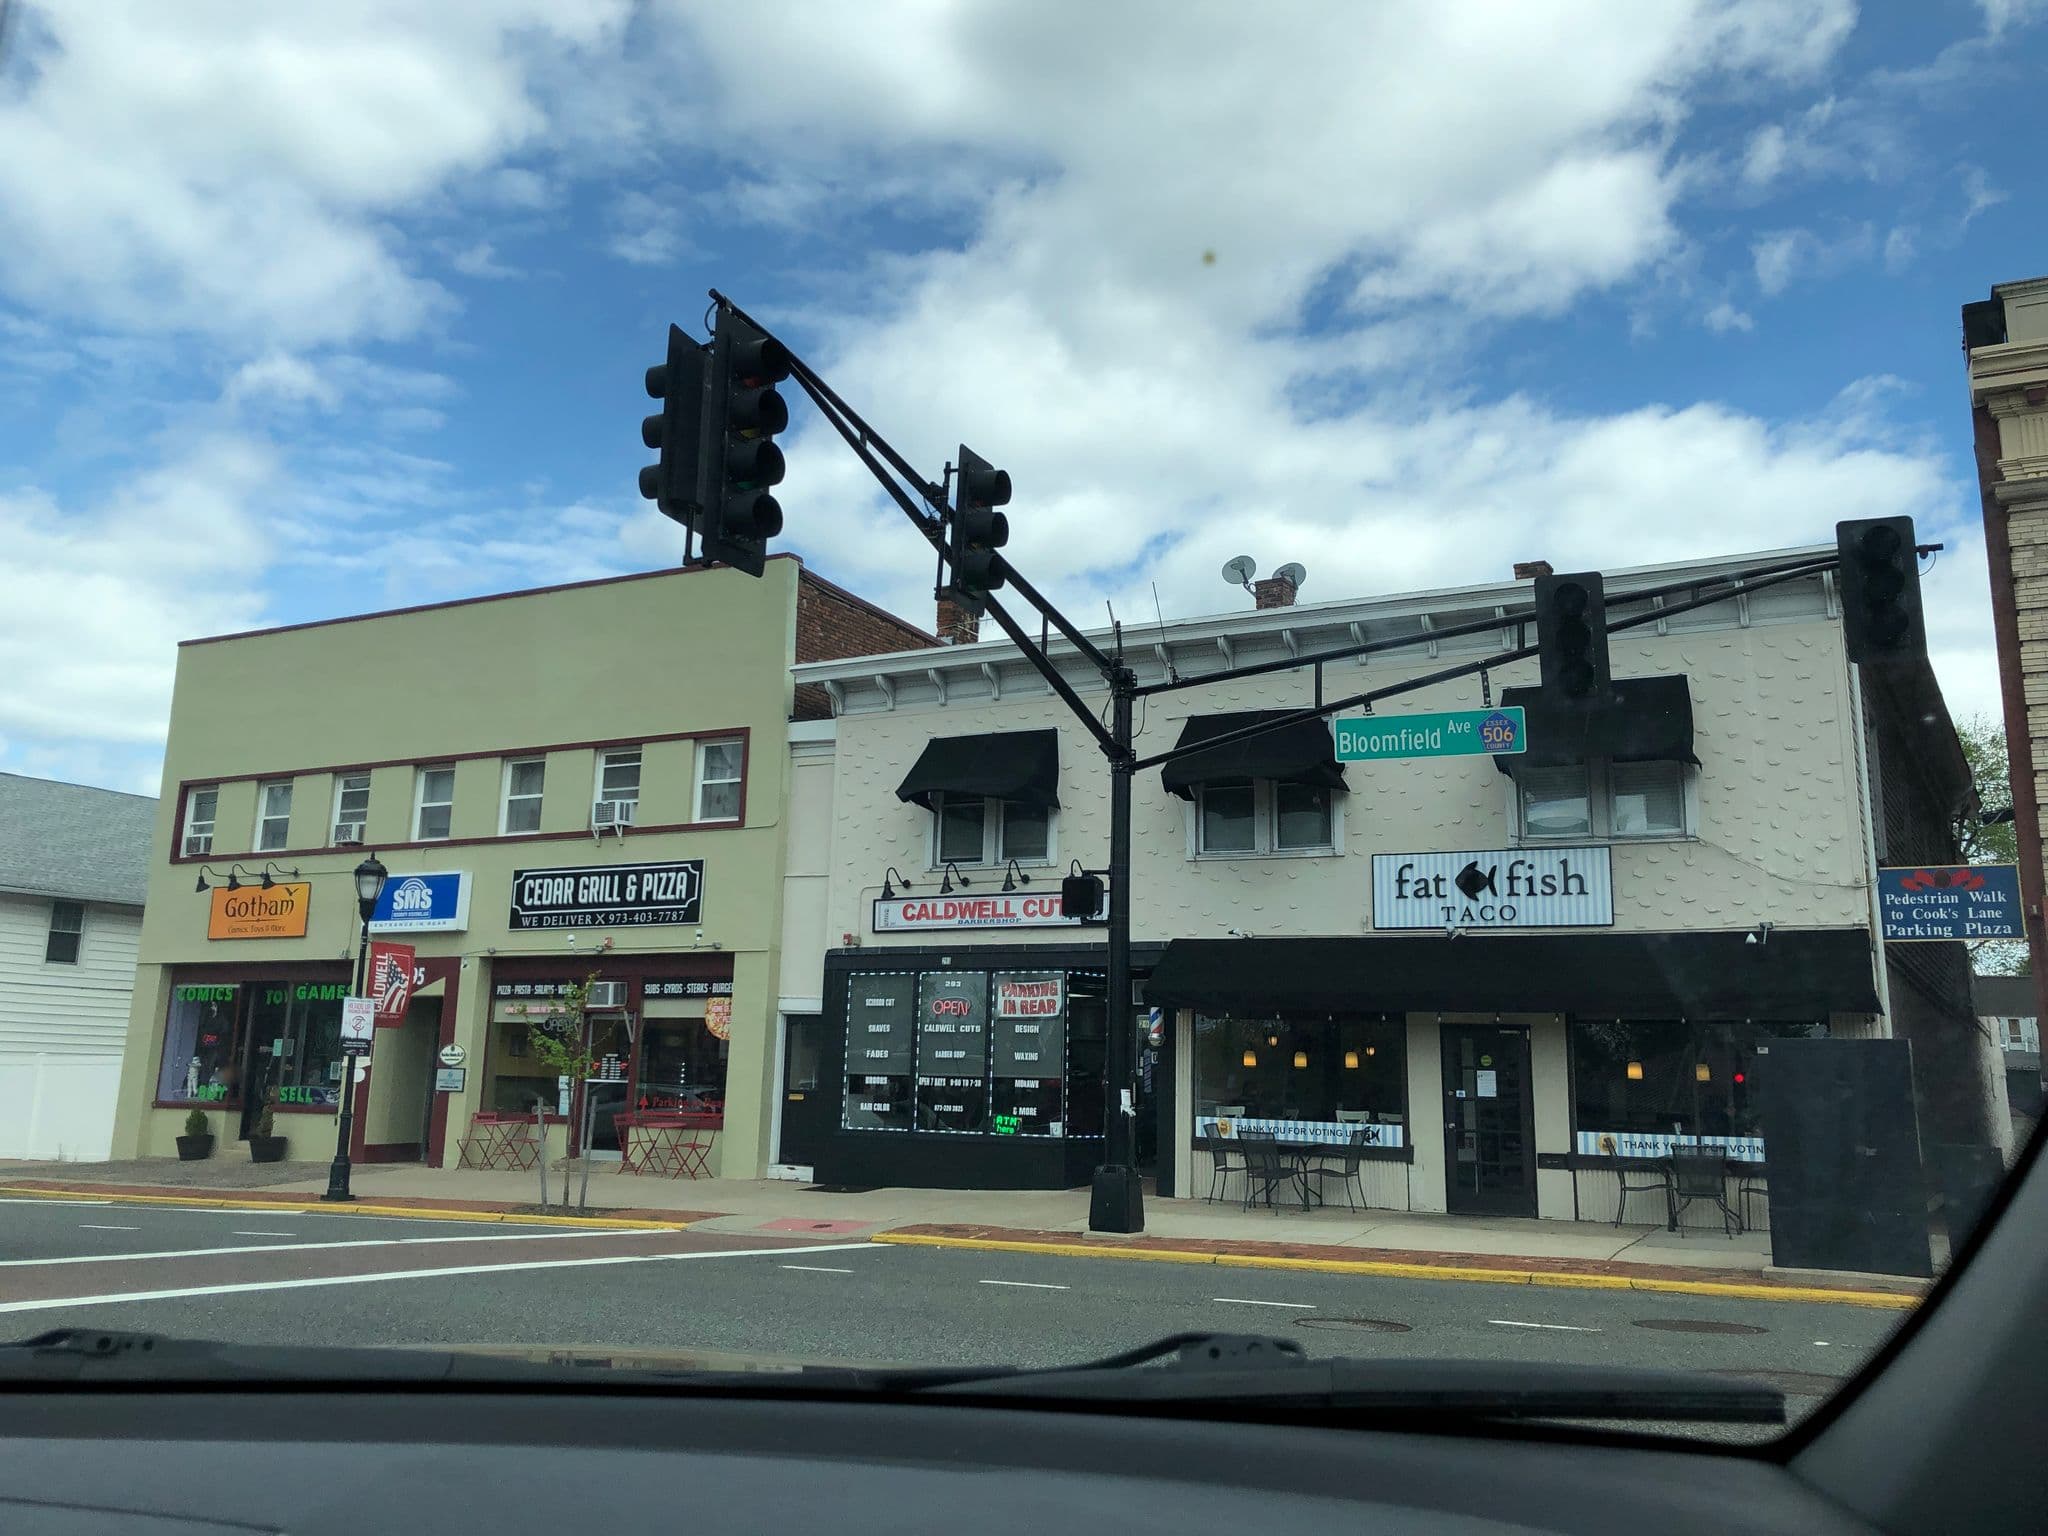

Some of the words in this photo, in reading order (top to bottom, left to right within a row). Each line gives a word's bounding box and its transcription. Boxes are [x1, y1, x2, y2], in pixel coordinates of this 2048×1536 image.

[1485, 719, 1508, 727] ESSEX
[1339, 728, 1441, 753] Bloomfield
[1447, 720, 1471, 734] Ave
[1483, 727, 1513, 743] 506
[1395, 863, 1448, 899] fat
[1506, 857, 1589, 897] fish
[523, 877, 574, 906] CEDAR
[578, 874, 621, 904] GRILL
[626, 874, 637, 901] &
[641, 871, 688, 901] PIZZA
[392, 888, 433, 910] SMS
[1885, 892, 1959, 905] Pedestrian
[1968, 890, 2007, 903] Walk
[225, 895, 294, 918] Gotham
[902, 900, 1017, 922] CALDWELL
[1440, 904, 1517, 922] TACO
[1891, 910, 1904, 920] to
[1912, 907, 1959, 920] Cook's
[1967, 907, 2003, 919] Lane
[521, 916, 538, 927] WE
[542, 914, 592, 926] DELIVER
[608, 911, 685, 924] 973-403-7787
[958, 917, 1022, 925] BARBERSHOP
[1886, 923, 1953, 937] Parking
[1965, 922, 2012, 935] Plaza
[373, 952, 389, 1012] CALDWELL
[496, 985, 511, 995] PIZZA
[514, 984, 532, 995] PASTA
[644, 983, 660, 994] SUBS
[663, 983, 683, 994] GYROS
[686, 983, 709, 993] STEAKS
[1002, 981, 1059, 997] PARKING
[176, 986, 233, 1001] COMICS
[932, 1000, 969, 1016] OPEN
[1003, 999, 1017, 1015] IN
[1020, 998, 1057, 1015] REAR
[924, 1024, 956, 1033] CALDWELL
[1014, 1024, 1040, 1033] DESIGN
[866, 1050, 889, 1058] FADES
[1014, 1051, 1039, 1060] WAXING
[279, 1086, 313, 1103] SELL
[1019, 1106, 1038, 1116] MORE
[996, 1115, 1017, 1126] ATM
[1236, 1124, 1265, 1134] THANK
[1267, 1125, 1286, 1135] YOU
[1288, 1127, 1306, 1135] FOR
[1309, 1128, 1344, 1138] VOTING
[1623, 1140, 1660, 1150] THANK
